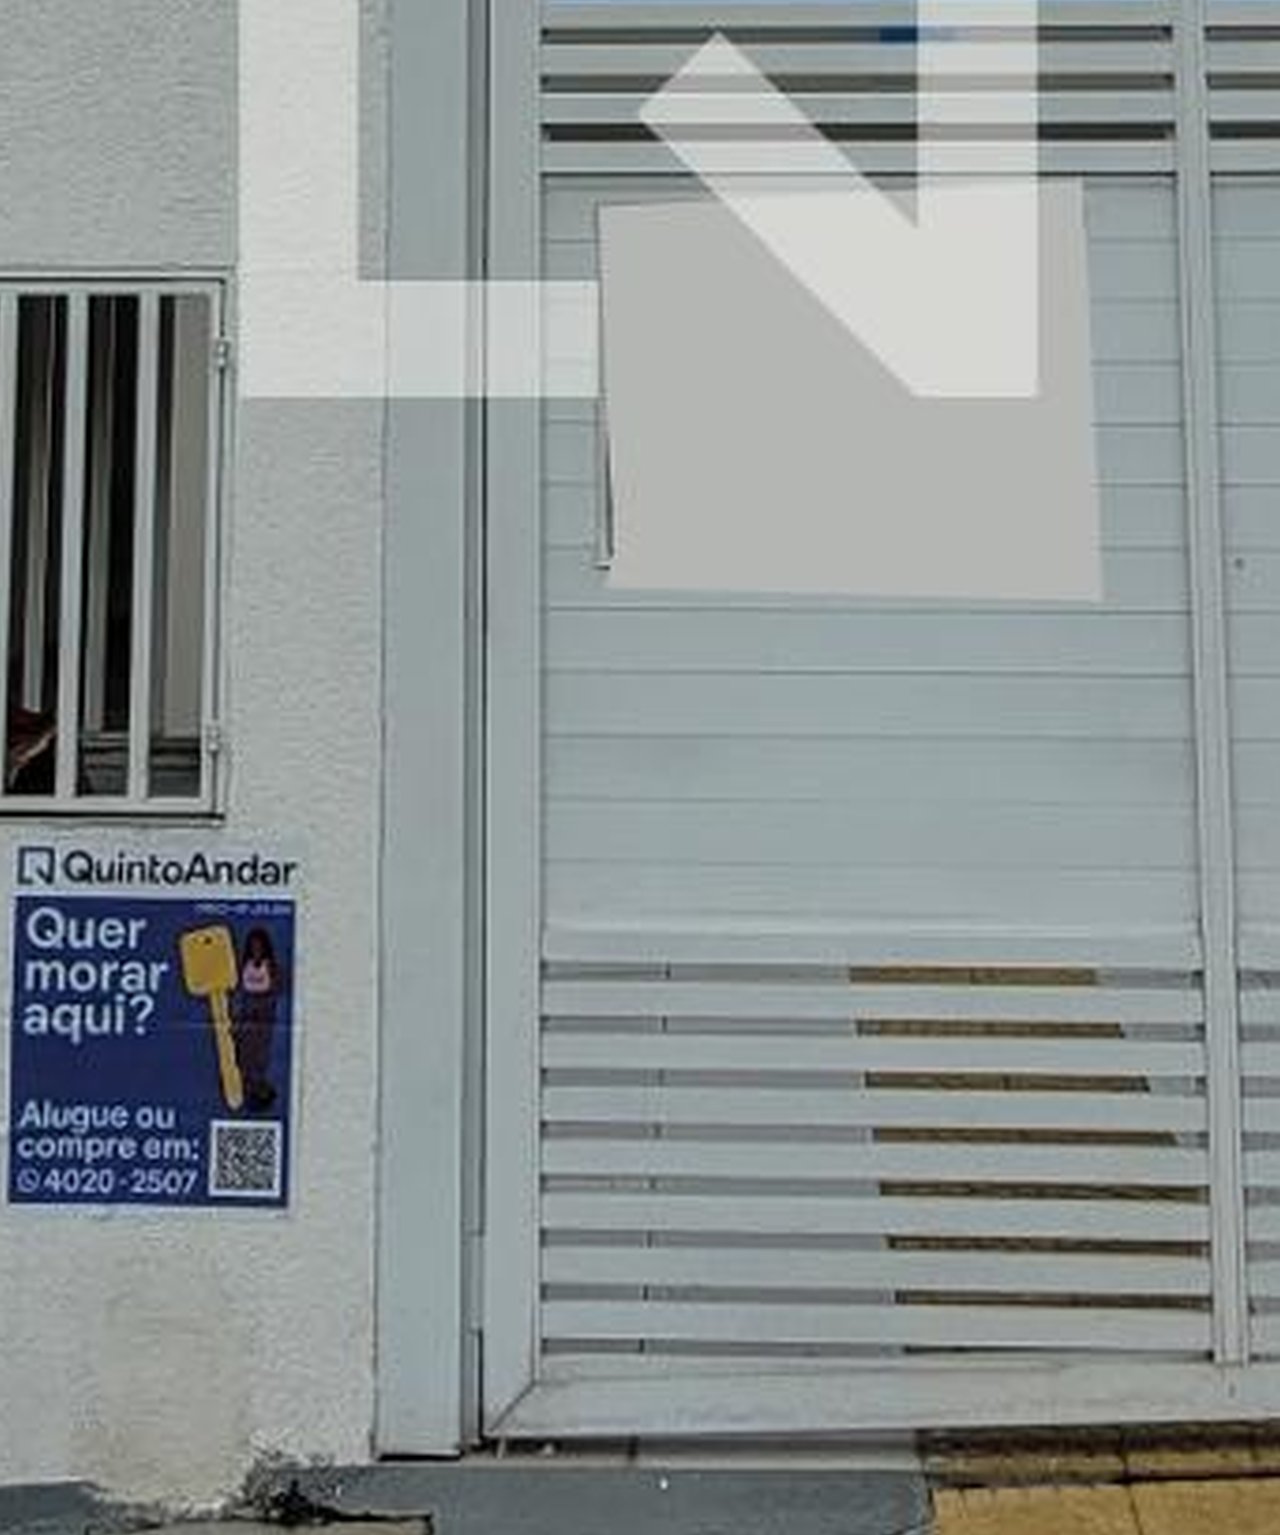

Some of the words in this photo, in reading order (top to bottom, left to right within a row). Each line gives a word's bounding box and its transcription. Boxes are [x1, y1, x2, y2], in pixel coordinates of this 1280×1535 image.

[62, 849, 297, 885] QuintoAndar
[26, 906, 147, 950] Quer
[24, 959, 169, 992] morar
[22, 994, 155, 1046] aqui?
[20, 1100, 130, 1134] Alugue
[135, 1107, 176, 1129] ou
[16, 1137, 137, 1164] compre
[142, 1138, 200, 1160] em:
